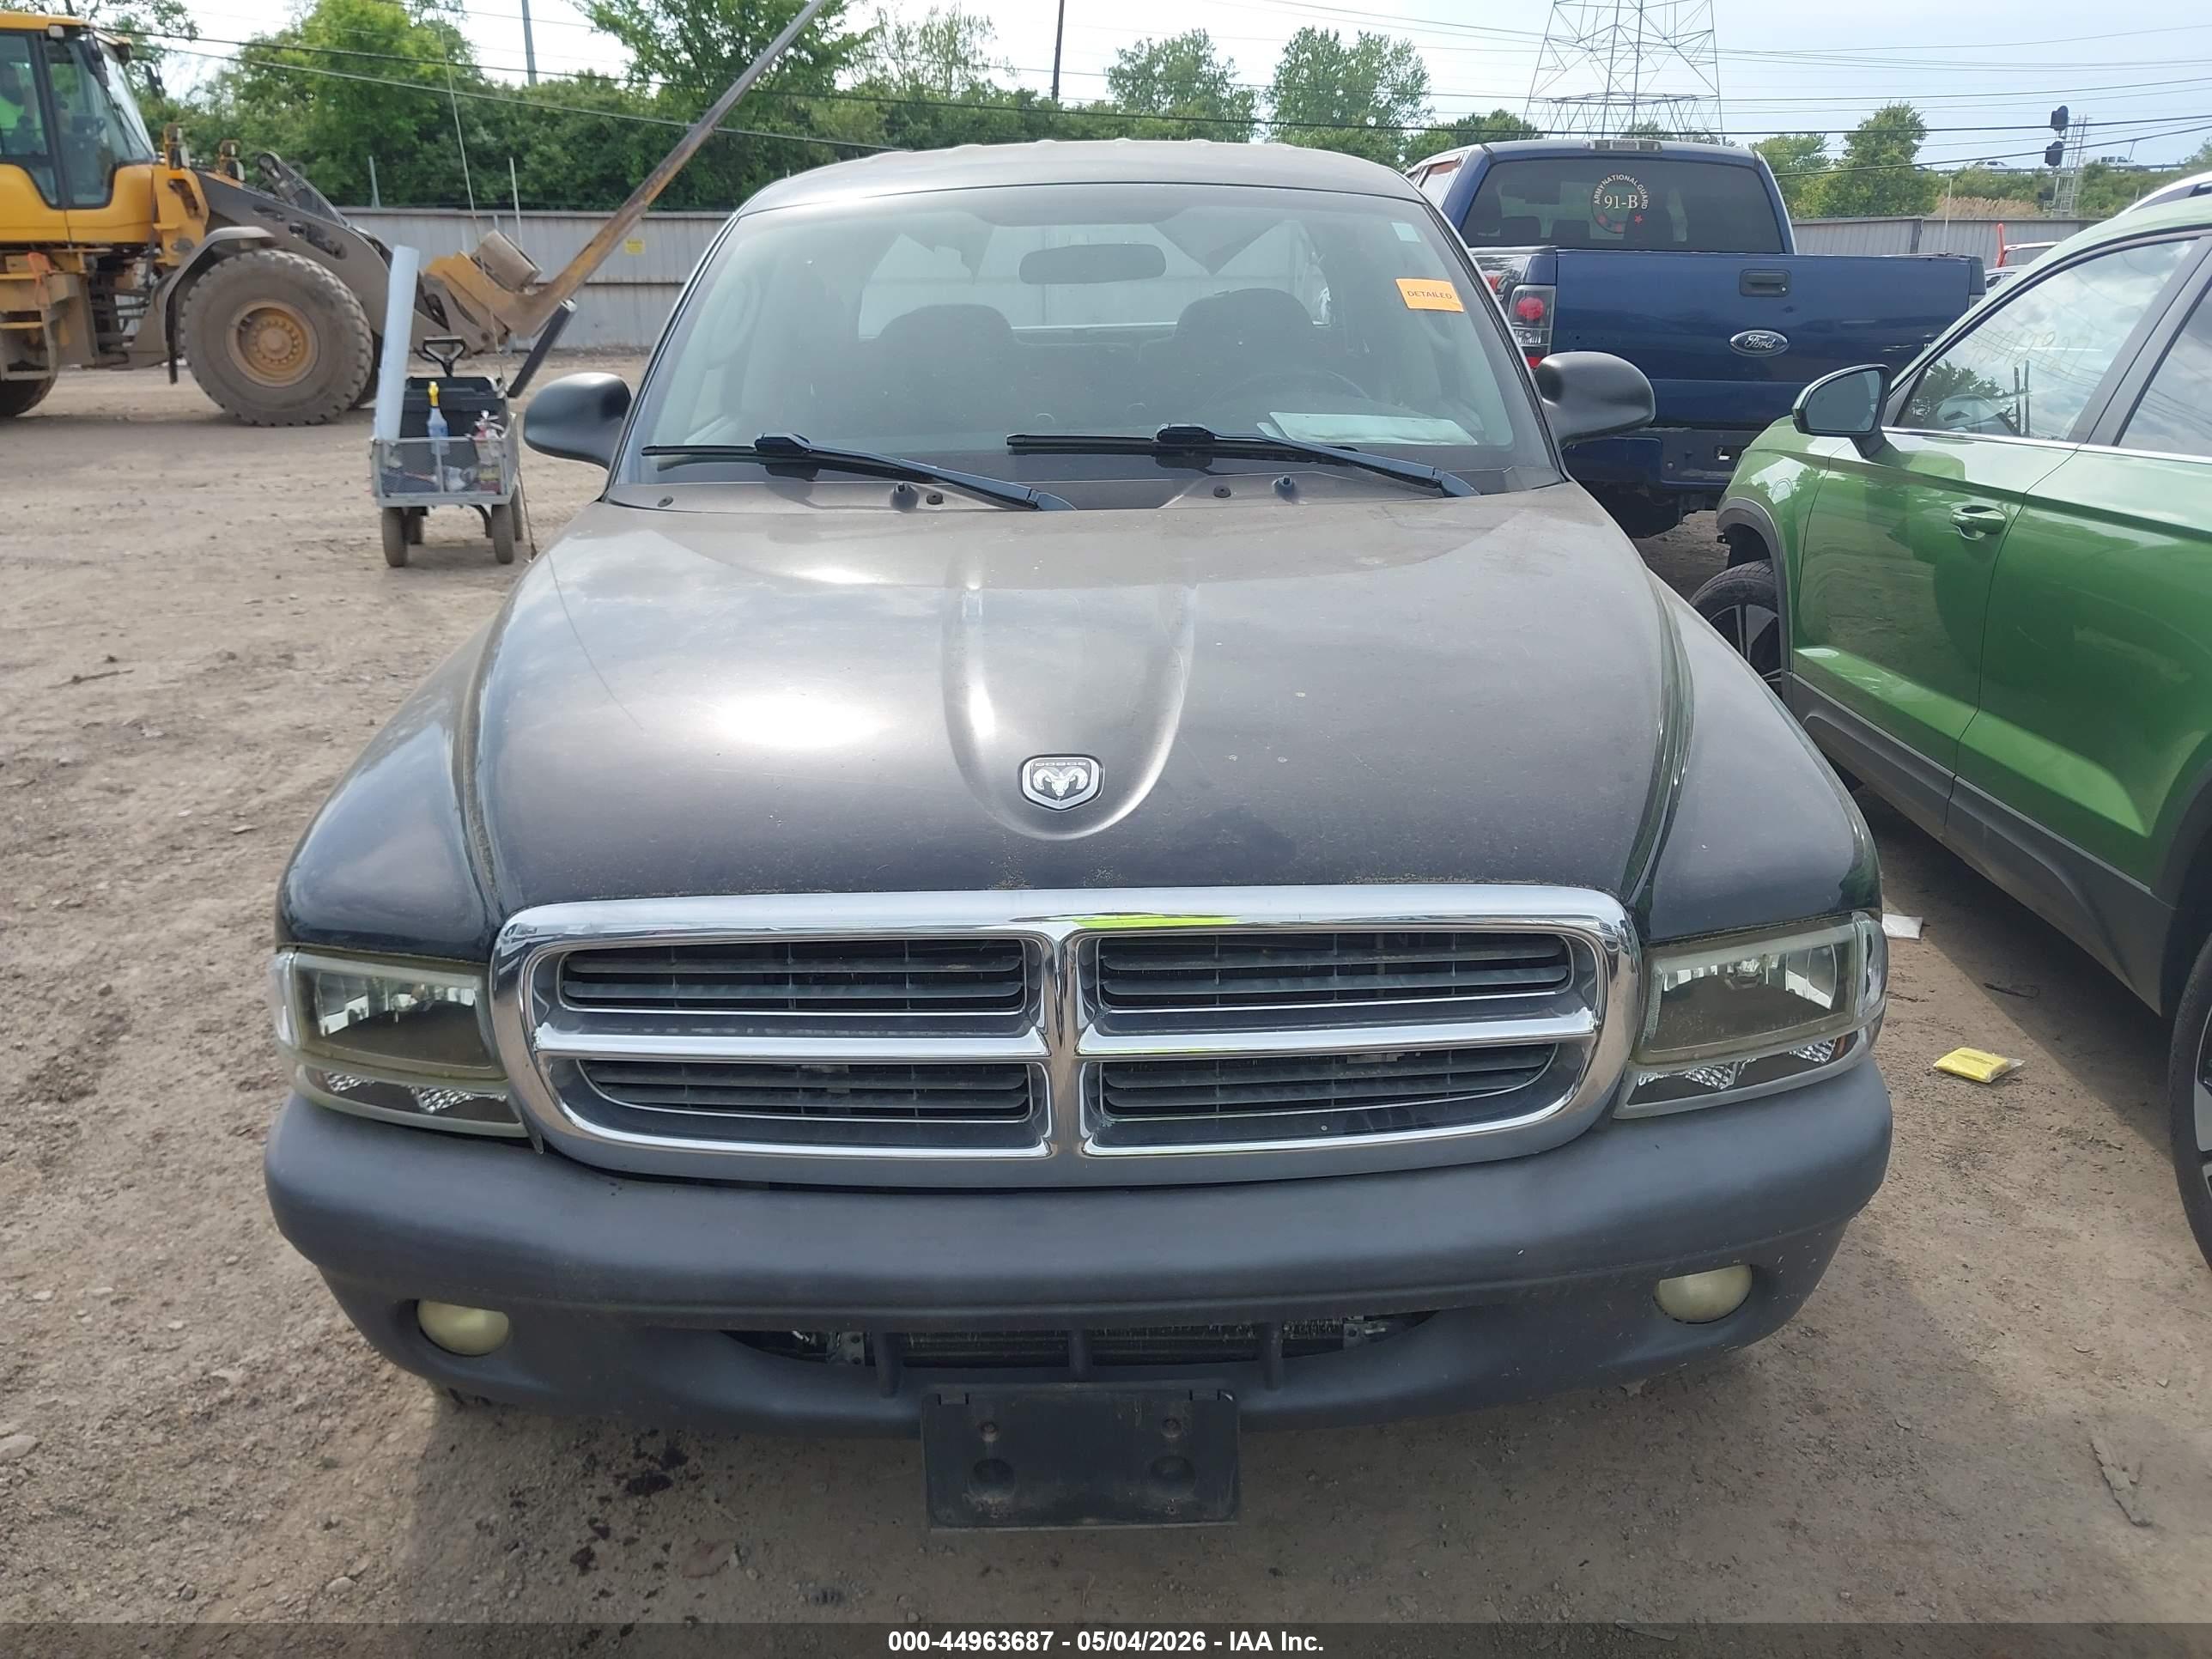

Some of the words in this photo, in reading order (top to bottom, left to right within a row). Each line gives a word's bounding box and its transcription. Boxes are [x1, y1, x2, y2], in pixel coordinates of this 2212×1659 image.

[1594, 184, 1605, 204] ARMY
[1601, 173, 1638, 186] NATIONAL
[1637, 184, 1649, 210] GUARD
[1604, 194, 1638, 210] 91-B
[1407, 290, 1453, 300] DETAILED
[1744, 334, 1777, 349] Ford
